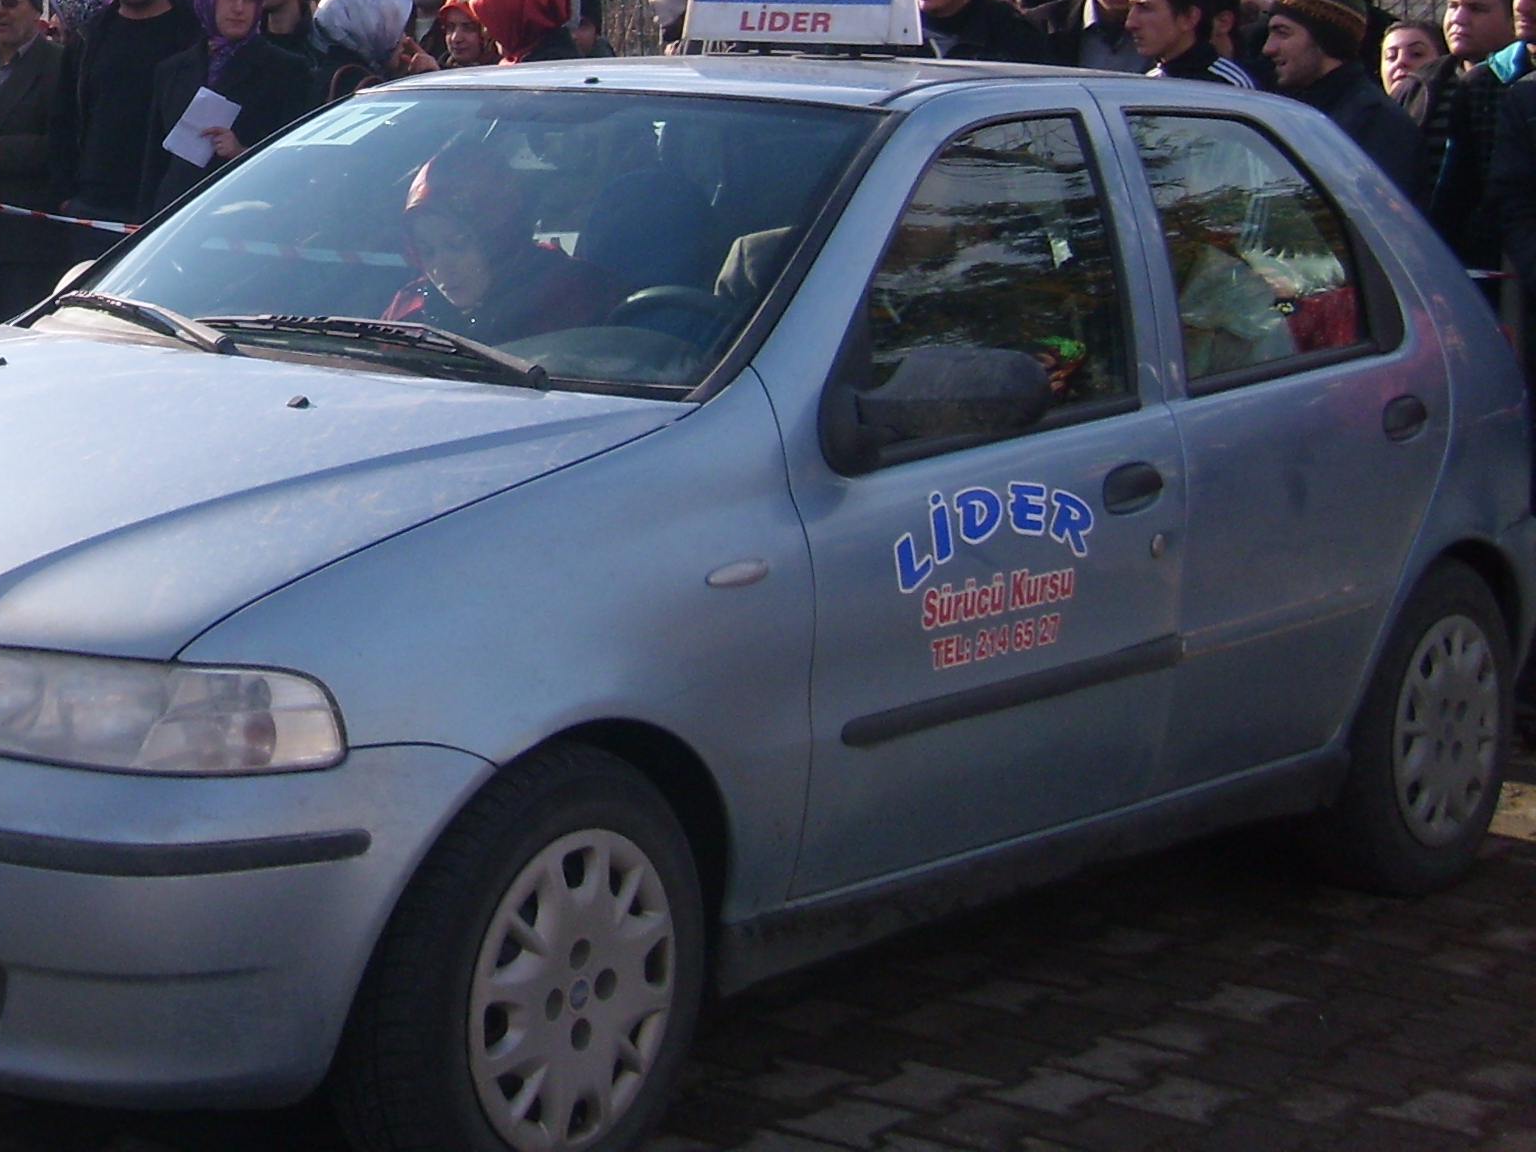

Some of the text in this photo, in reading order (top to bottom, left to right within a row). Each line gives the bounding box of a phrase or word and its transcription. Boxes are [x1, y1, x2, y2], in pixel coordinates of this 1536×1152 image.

[921, 568, 1075, 630] Sürücü Kursu
[932, 613, 1061, 670] TEL: 214 65 27
